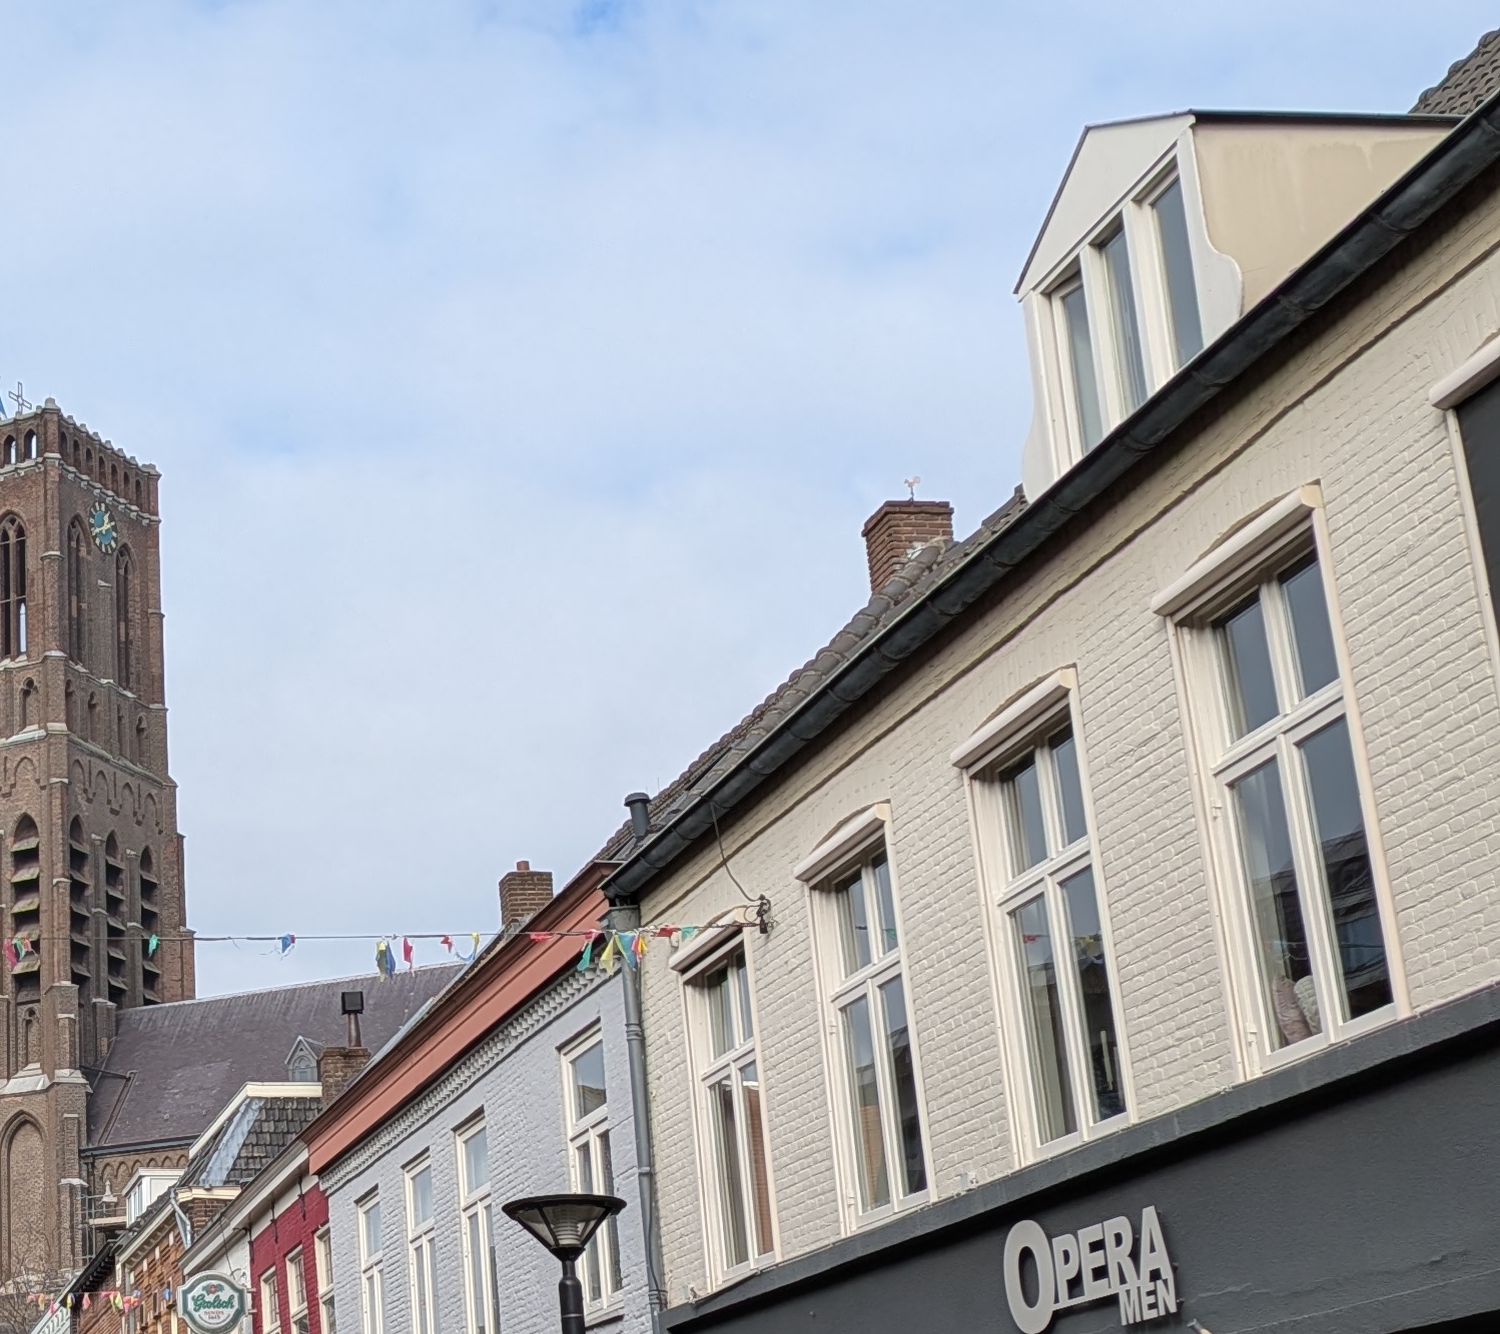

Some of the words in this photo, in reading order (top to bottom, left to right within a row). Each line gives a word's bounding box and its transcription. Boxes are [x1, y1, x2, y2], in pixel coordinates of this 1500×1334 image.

[1003, 1205, 1174, 1334] OPERA
[191, 1293, 235, 1312] Grolsch
[1118, 1278, 1178, 1326] MEN
